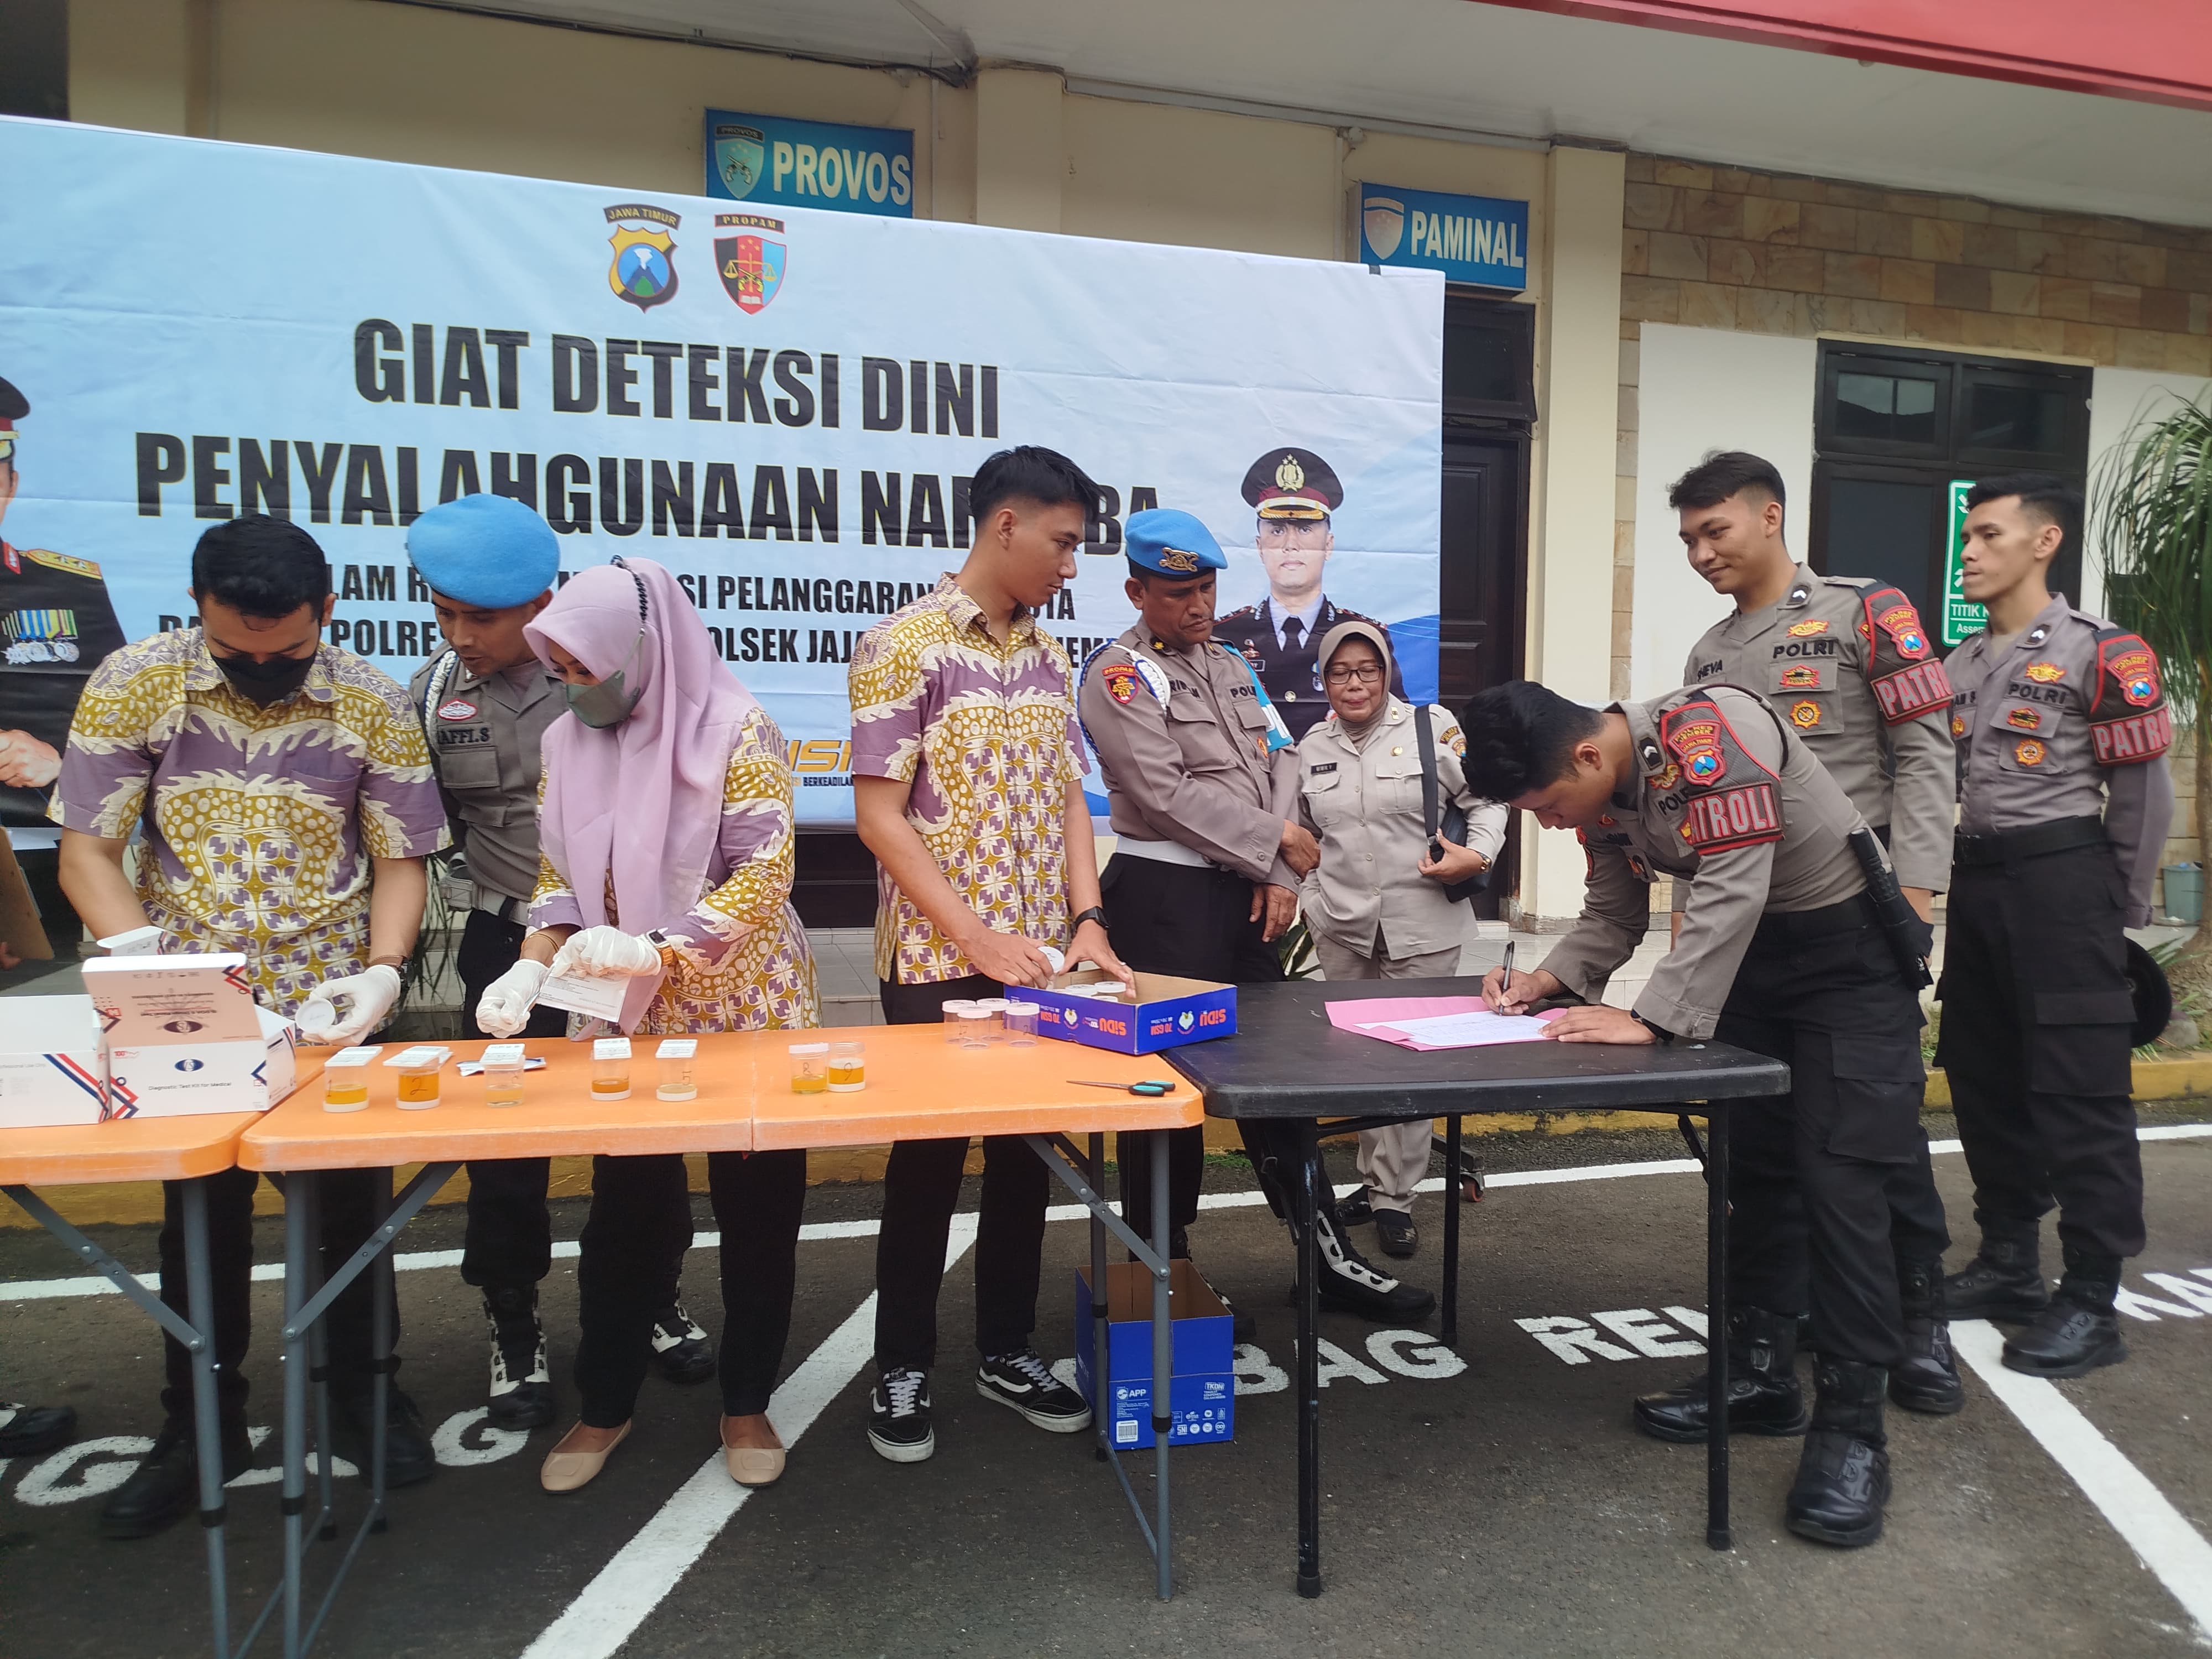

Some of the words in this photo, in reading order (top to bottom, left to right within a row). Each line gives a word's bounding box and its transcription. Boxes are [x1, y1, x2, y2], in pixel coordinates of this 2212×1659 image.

[773, 140, 911, 206] PROVOS
[609, 207, 640, 220] JAWA
[641, 208, 677, 226] TIMUR
[722, 216, 777, 229] PROPAM
[1411, 210, 1524, 269] PAMINAL
[354, 318, 530, 410] GIAT
[552, 332, 841, 429] DETEKSI
[861, 356, 1000, 440] DINI
[1950, 603, 1980, 617] TITIK
[1772, 639, 1835, 659] POLRI
[2008, 683, 2067, 705] POLRI
[2093, 708, 2172, 760] PATRO
[1098, 1018, 1127, 1036] SiDU
[1199, 1009, 1227, 1026] SiDU
[843, 1062, 853, 1082] 9
[409, 1077, 428, 1095] 2
[1232, 1329, 1469, 1396] BAG
[1129, 1389, 1147, 1398] APP
[1177, 1426, 1187, 1434] SNI
